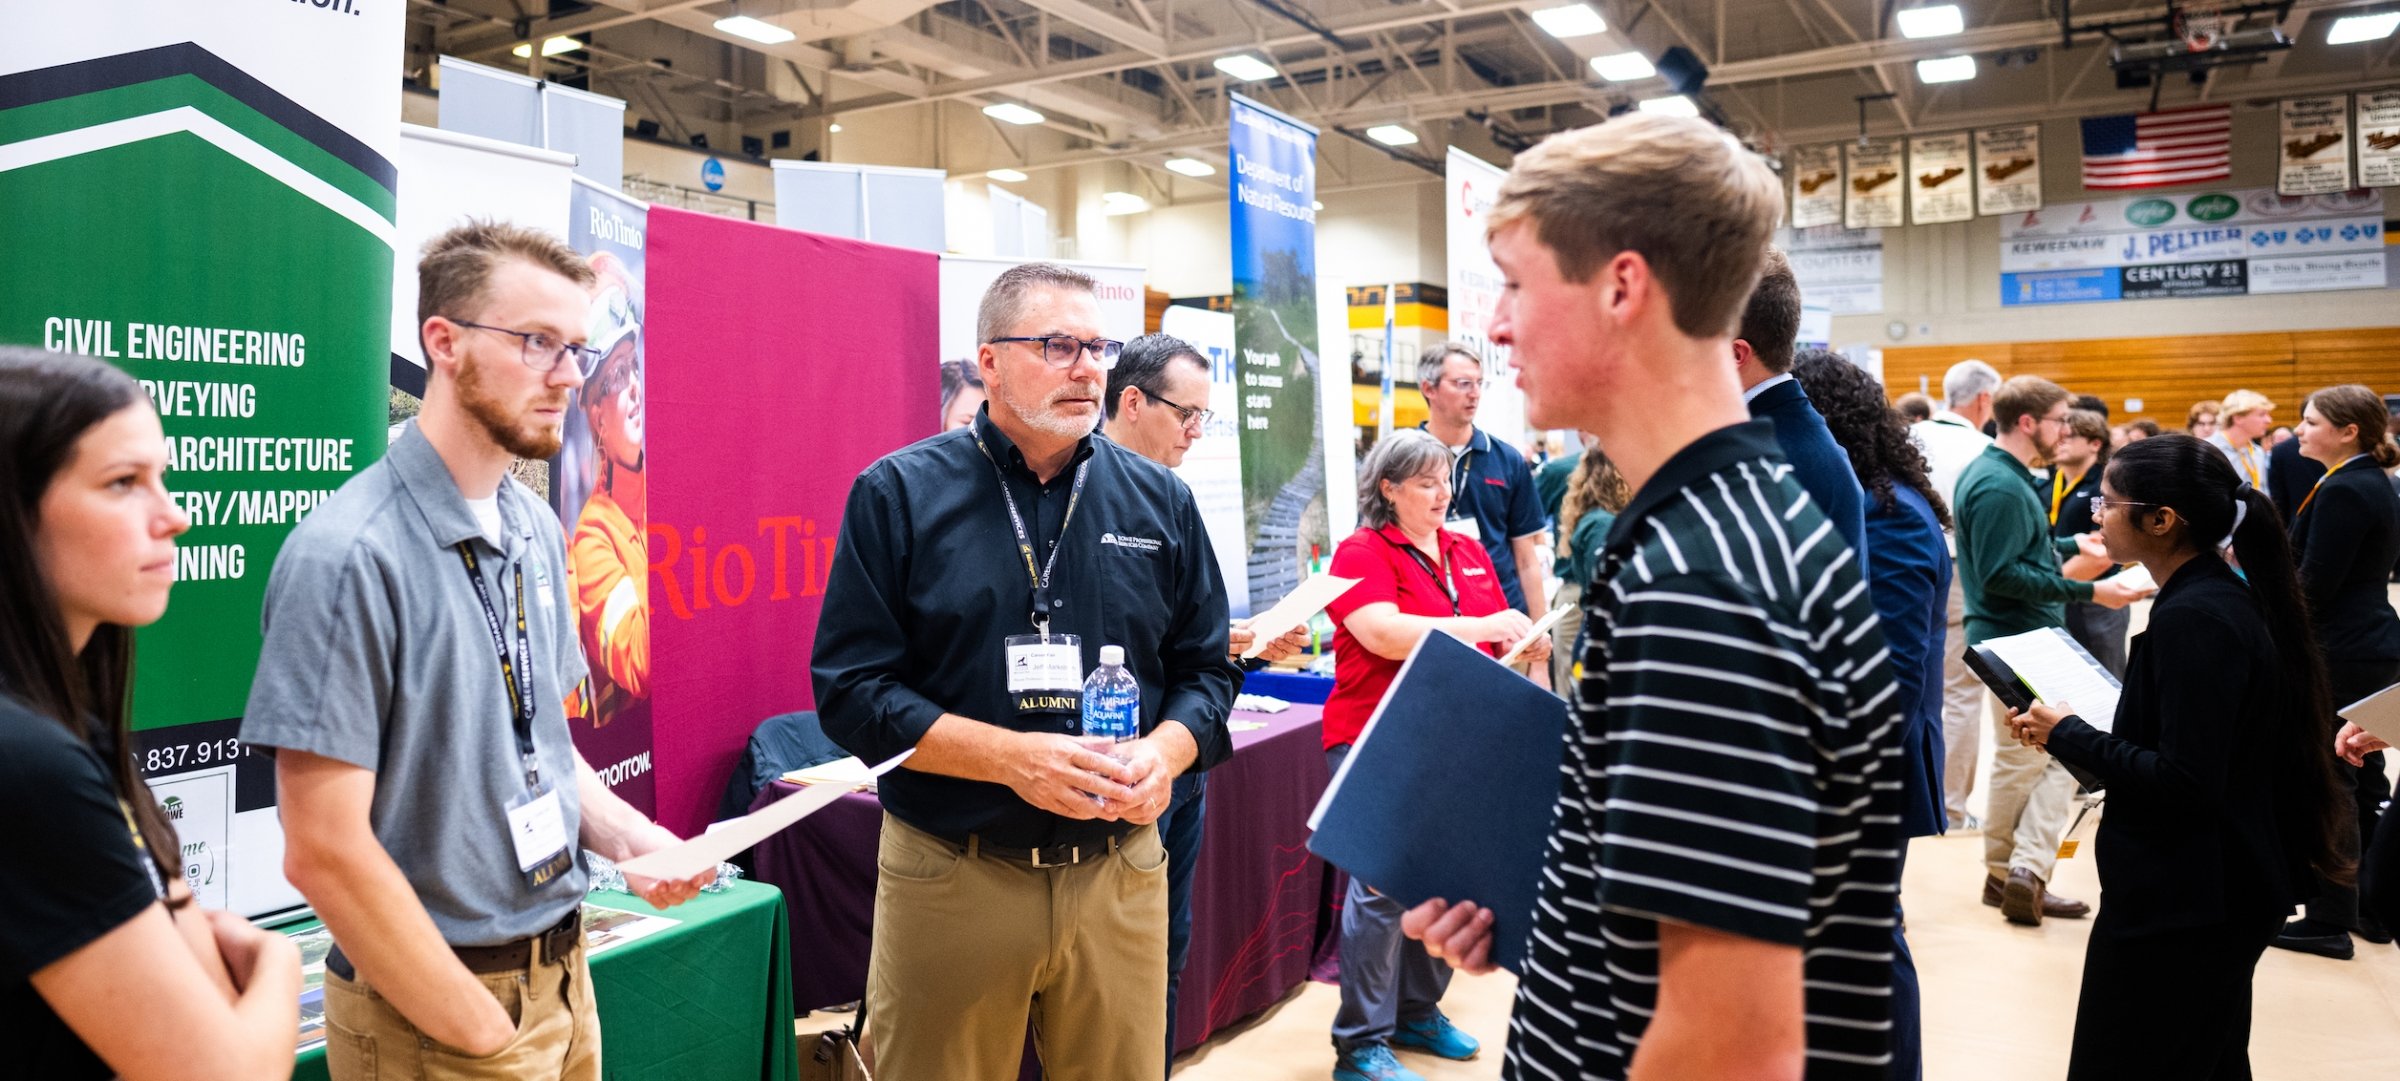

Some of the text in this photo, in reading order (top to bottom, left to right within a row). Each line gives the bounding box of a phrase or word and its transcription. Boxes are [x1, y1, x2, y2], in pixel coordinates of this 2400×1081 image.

[2012, 237, 2106, 256] KEWEENAW
[2123, 235, 2142, 261] J.
[2148, 229, 2242, 257] PELTIER
[2125, 261, 2240, 282] CENTURY 21
[44, 316, 306, 368] CIVIL ENGINEERING
[1243, 348, 1281, 369] Your path
[1244, 371, 1284, 389] to success
[138, 379, 256, 418] RVEYING
[1246, 394, 1272, 409] starts
[1246, 414, 1269, 430] here
[164, 436, 354, 472] ARCHITECTURE
[1019, 696, 1076, 709] ALUMNI
[1093, 710, 1125, 721] AQUAFINA
